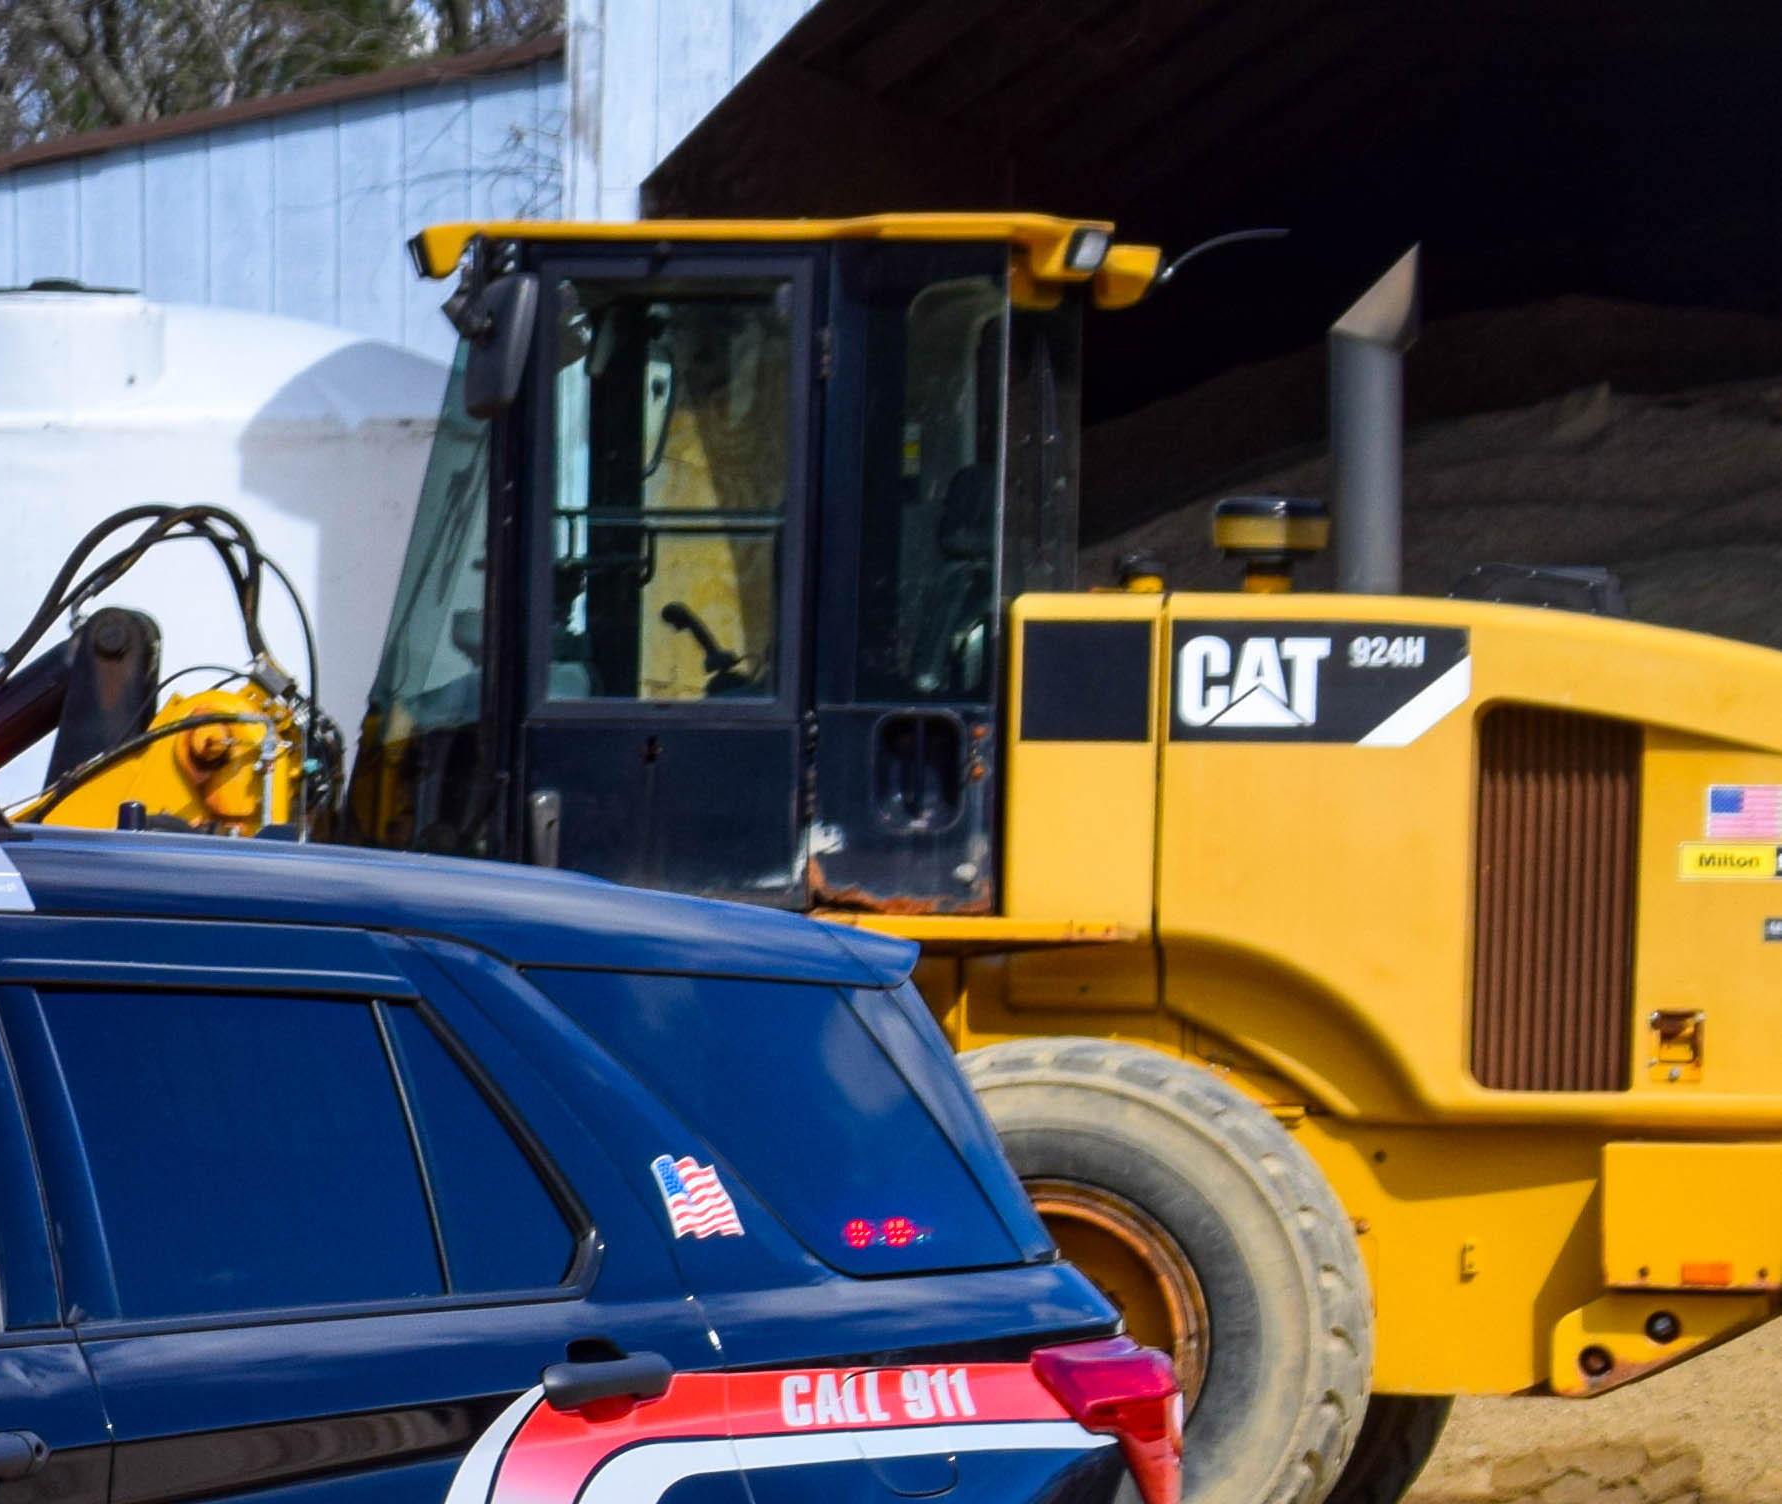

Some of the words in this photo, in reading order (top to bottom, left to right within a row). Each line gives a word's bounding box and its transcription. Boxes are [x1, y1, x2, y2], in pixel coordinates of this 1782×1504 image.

[1349, 636, 1425, 667] 924H
[1178, 635, 1331, 727] CAT
[1698, 853, 1761, 869] Milton
[781, 1372, 891, 1427] CALL
[902, 1367, 977, 1420] 911
